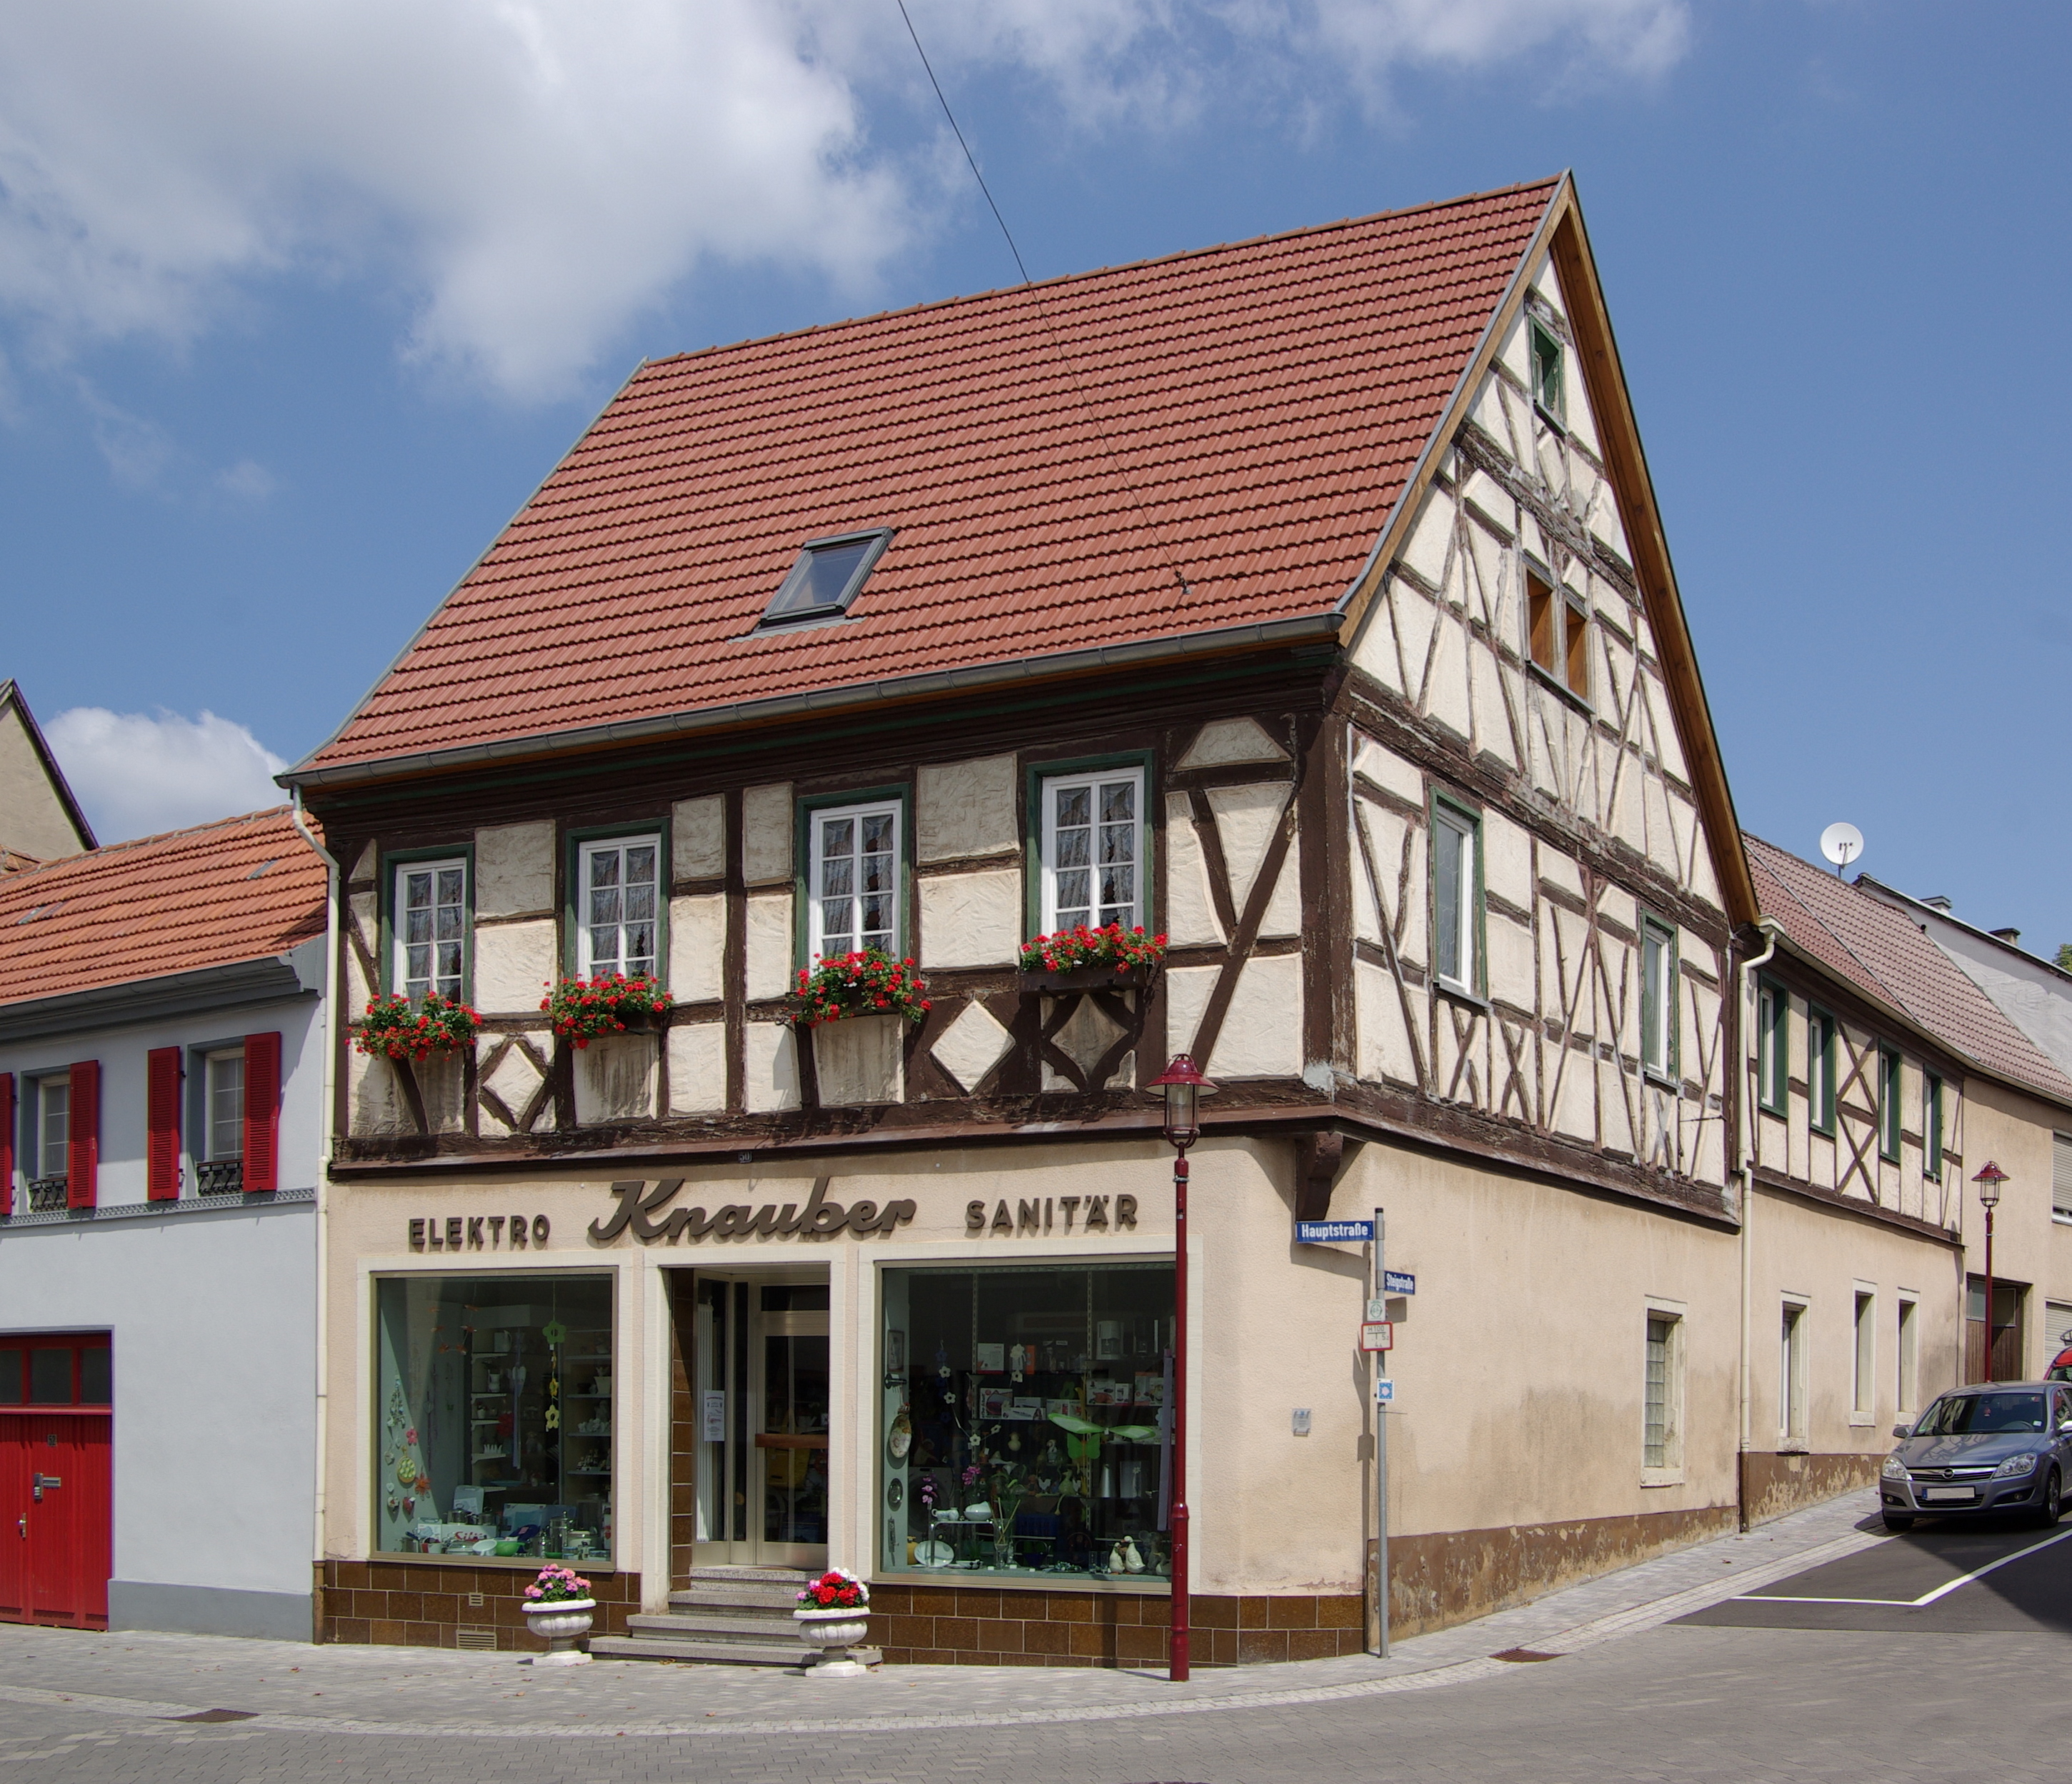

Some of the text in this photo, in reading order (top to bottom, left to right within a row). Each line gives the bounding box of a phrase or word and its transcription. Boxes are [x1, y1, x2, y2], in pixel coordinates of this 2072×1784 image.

[739, 1152, 751, 1161] 50
[409, 1176, 1138, 1244] ELEKTRO Knauber SANITÄR
[1301, 1222, 1368, 1240] Hauptstraße
[1386, 1273, 1414, 1291] Steigstraße
